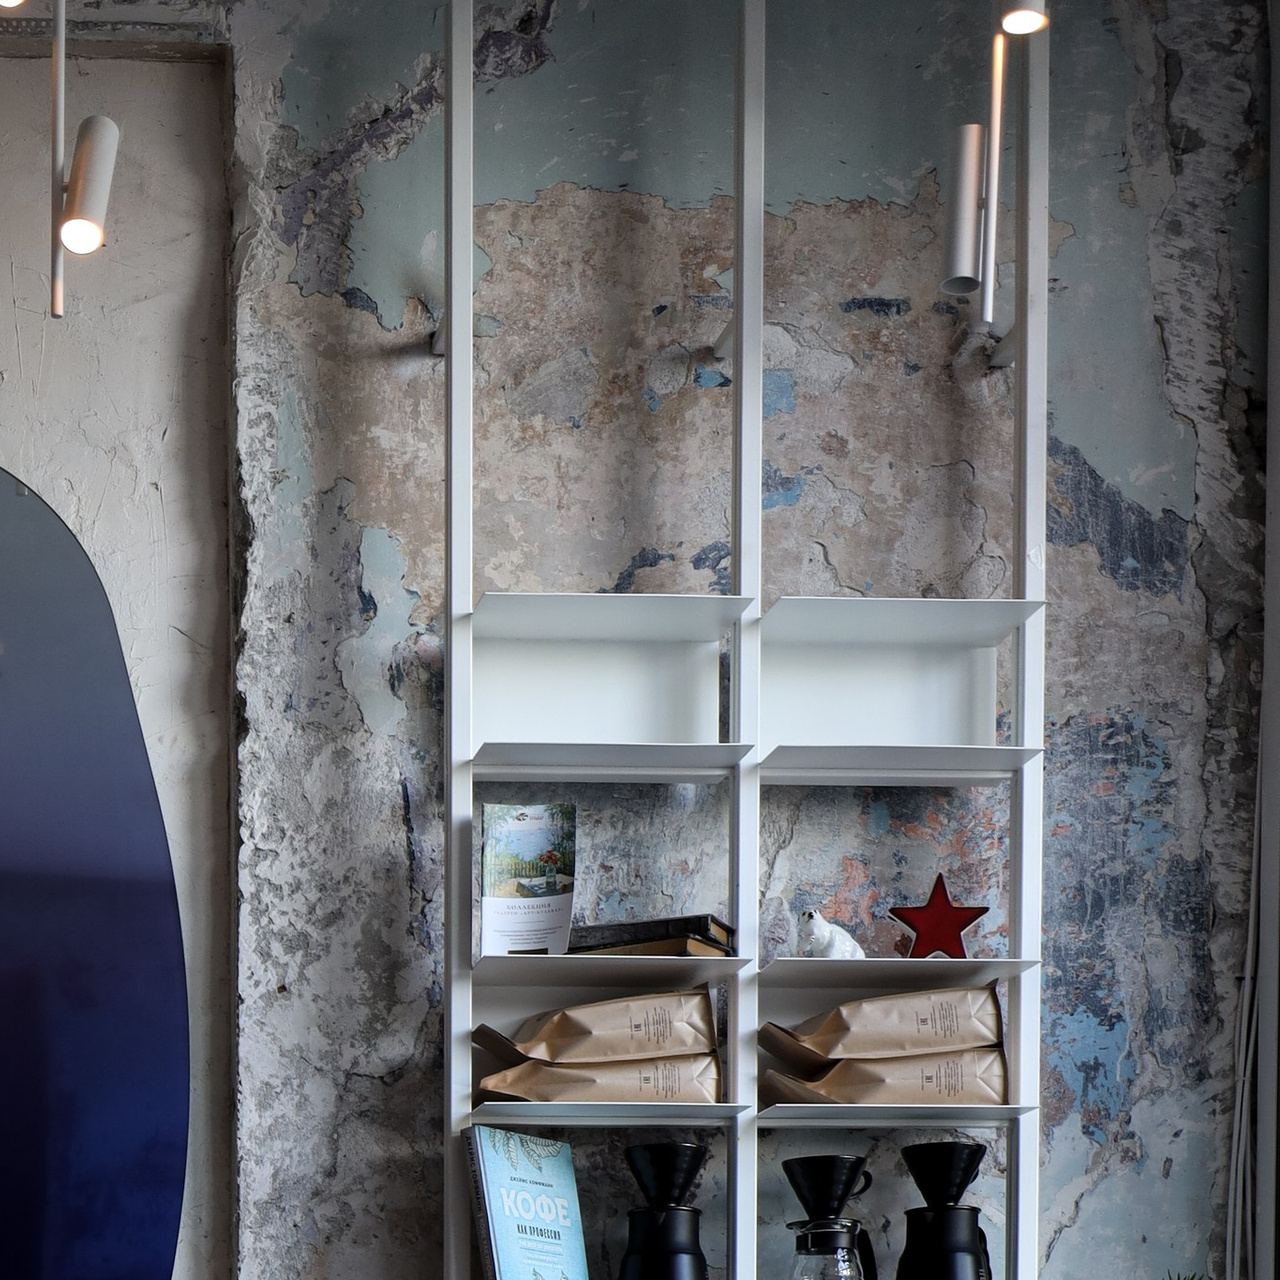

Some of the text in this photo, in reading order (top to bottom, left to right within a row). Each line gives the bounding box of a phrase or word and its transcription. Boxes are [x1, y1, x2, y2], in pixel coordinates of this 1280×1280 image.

[500, 1187, 572, 1227] КОФЕ
[517, 1224, 561, 1240] КАК ПРОФЕССИЯ
